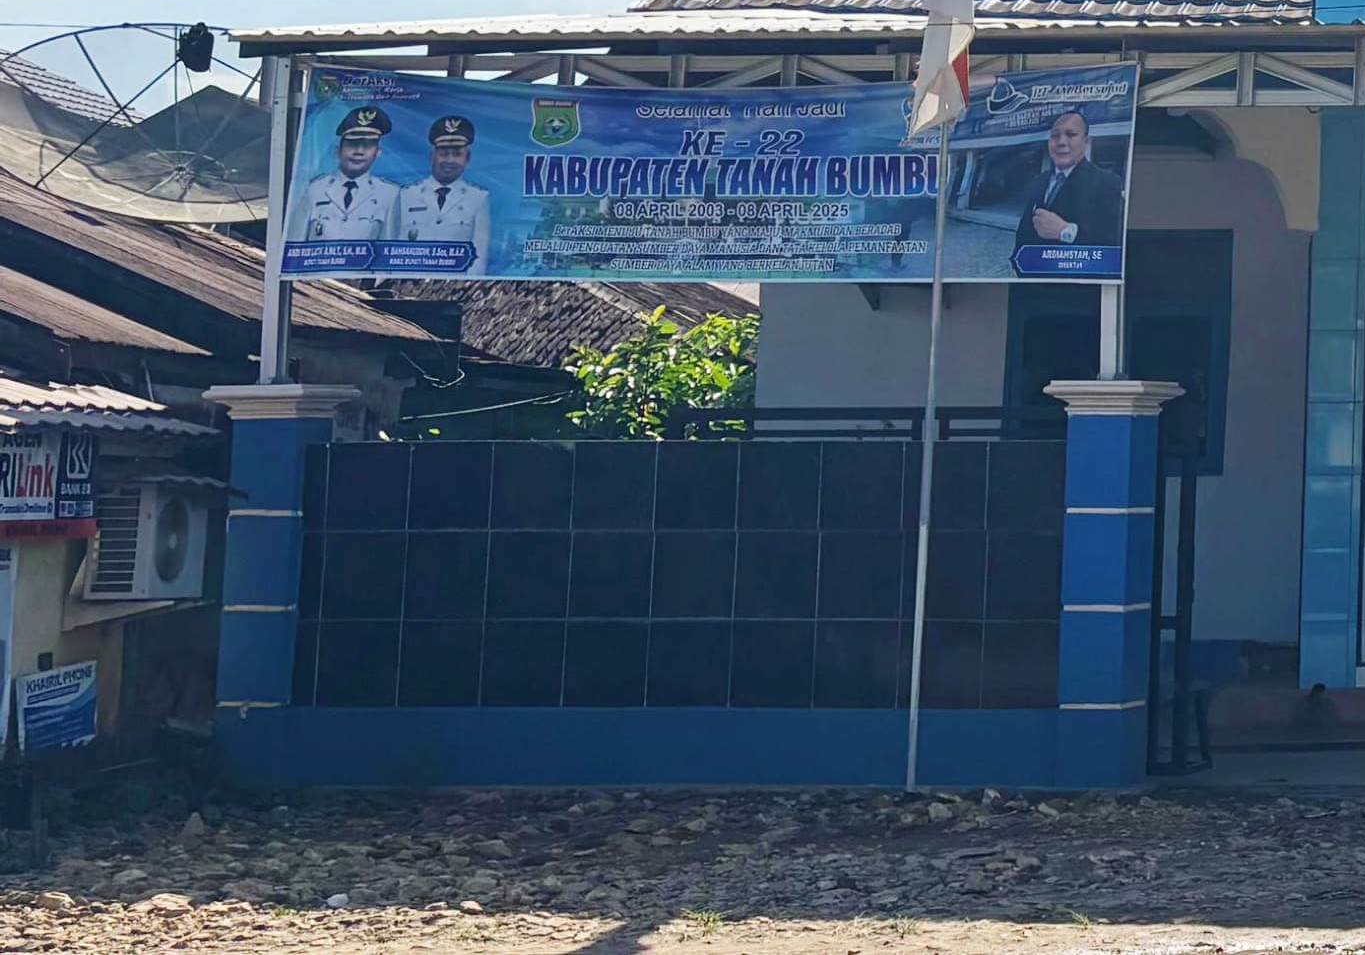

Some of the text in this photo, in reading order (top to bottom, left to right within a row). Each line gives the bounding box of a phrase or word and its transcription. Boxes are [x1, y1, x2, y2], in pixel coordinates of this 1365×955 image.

[680, 130, 727, 157] KE
[756, 129, 804, 157] 22
[523, 154, 709, 197] KABUPATEN
[715, 155, 820, 197] TANAH
[615, 202, 634, 218] 08
[635, 201, 685, 218] APRIL
[688, 202, 724, 218] 2003
[736, 202, 756, 219] 08
[757, 202, 809, 219] APRIL
[811, 202, 849, 218] 2025
[848, 240, 928, 253] PEMANFAATAN
[1091, 250, 1103, 260] SE
[610, 258, 656, 270] SUMBER
